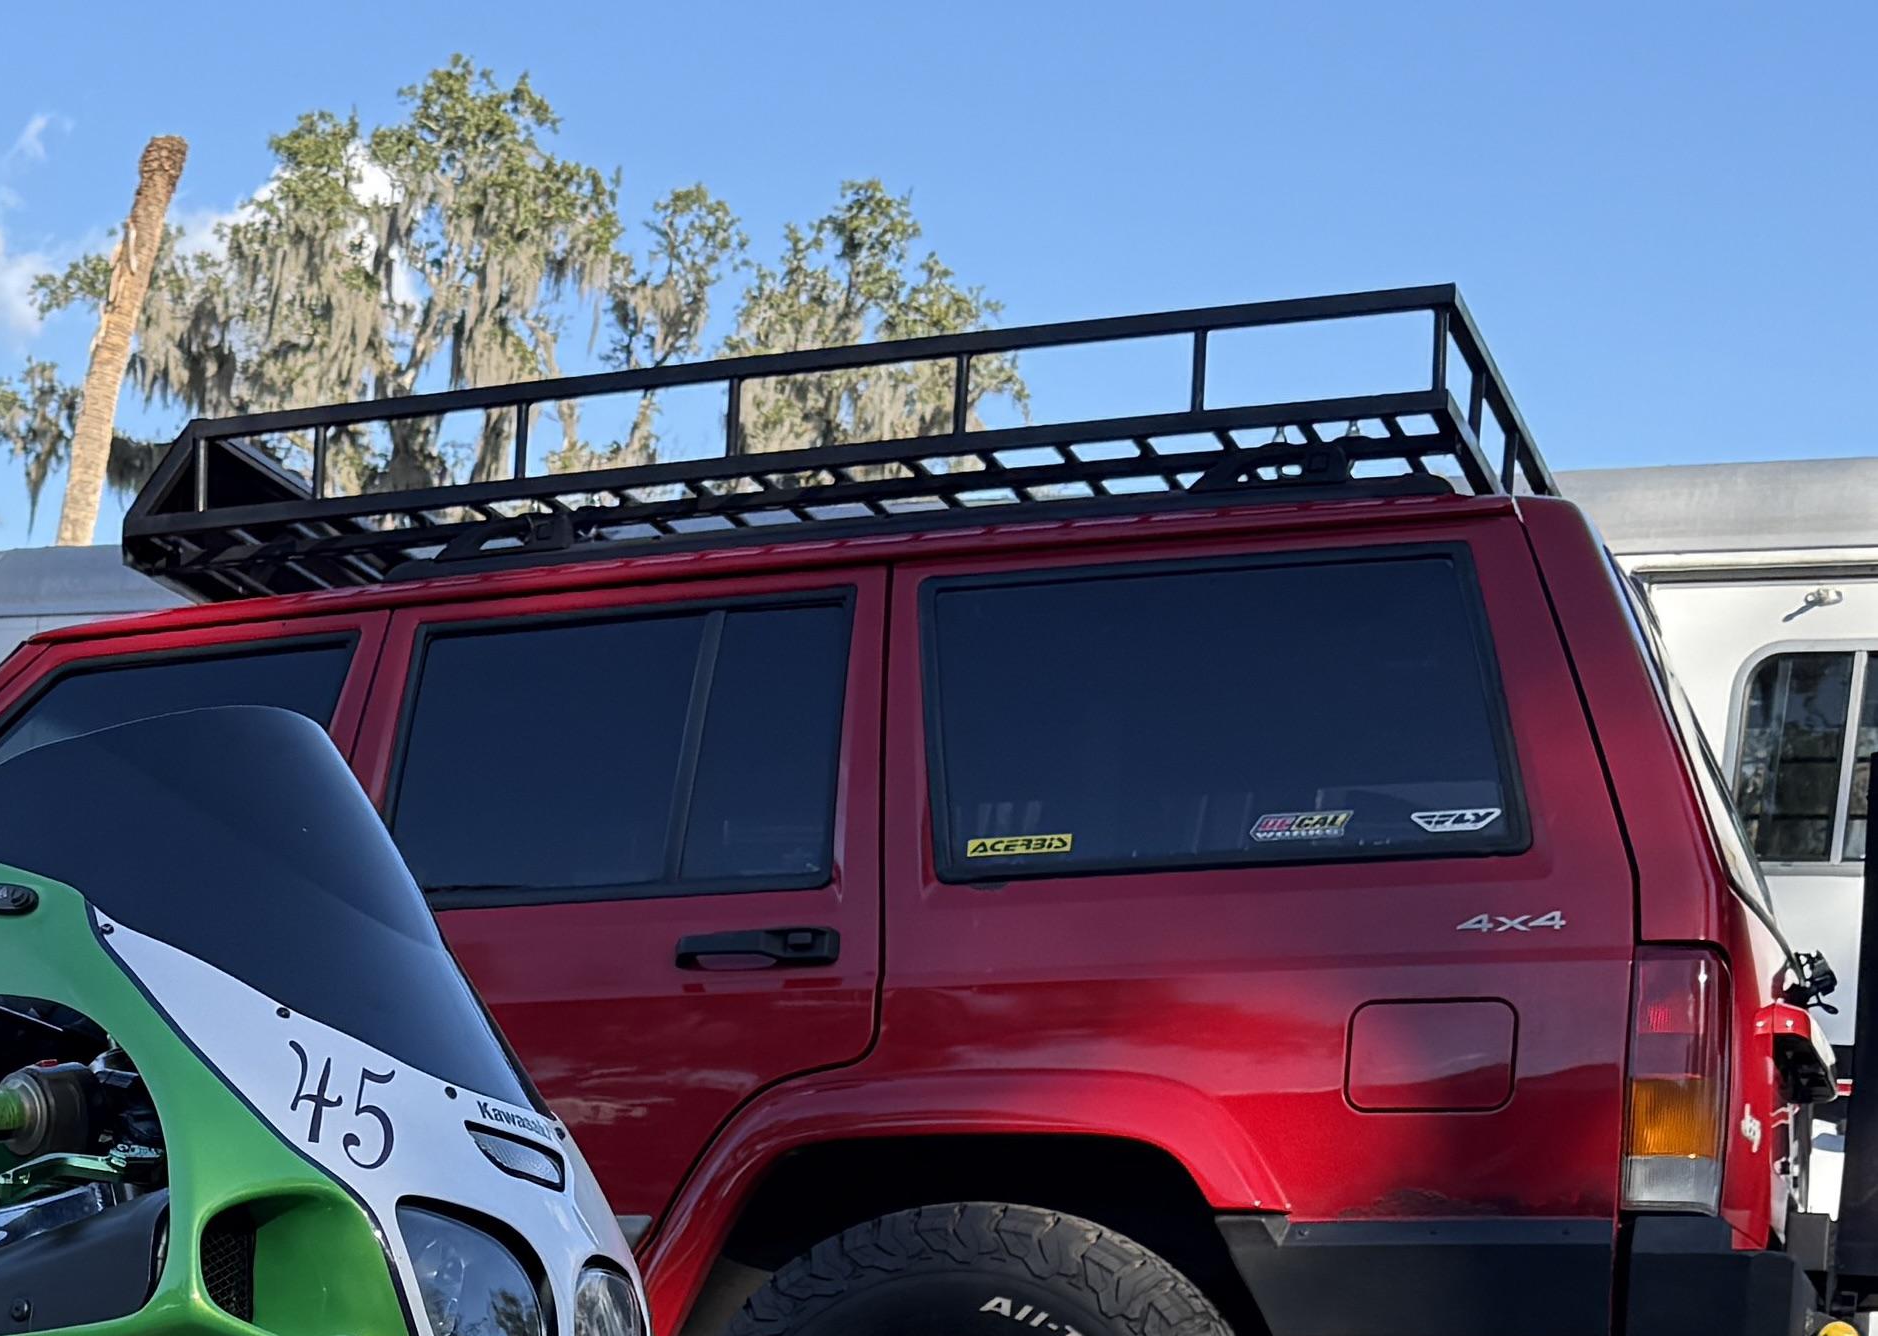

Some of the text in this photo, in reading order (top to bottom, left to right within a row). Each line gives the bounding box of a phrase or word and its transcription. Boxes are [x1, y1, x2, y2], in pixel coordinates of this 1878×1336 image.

[1416, 811, 1496, 827] FLY
[971, 837, 1067, 855] ACERBIS
[288, 1039, 396, 1170] 45
